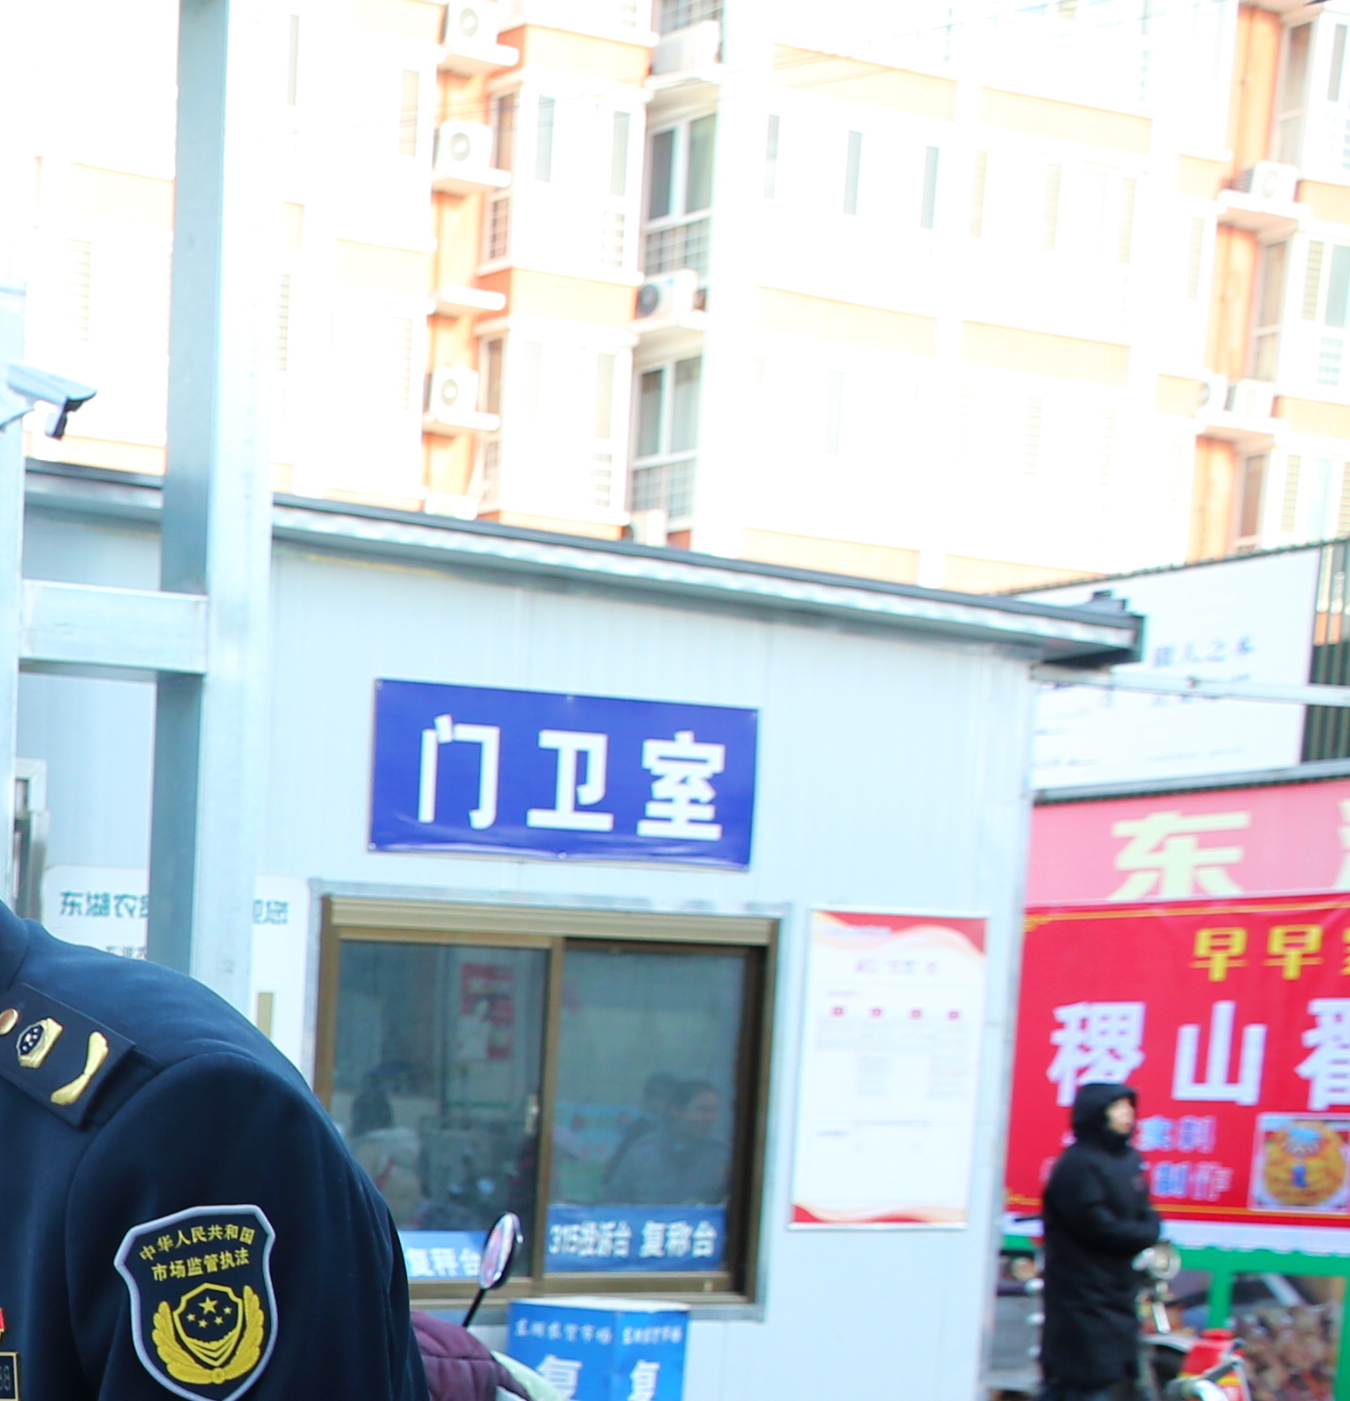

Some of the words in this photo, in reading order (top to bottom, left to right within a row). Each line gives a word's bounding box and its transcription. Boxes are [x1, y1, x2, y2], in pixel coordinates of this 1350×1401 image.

[417, 714, 726, 843] 门卫室
[1105, 810, 1350, 900] 东
[1191, 924, 1350, 983] 早早
[138, 1224, 257, 1263] 中华人民共和国
[151, 1248, 251, 1283] 市场监管执法
